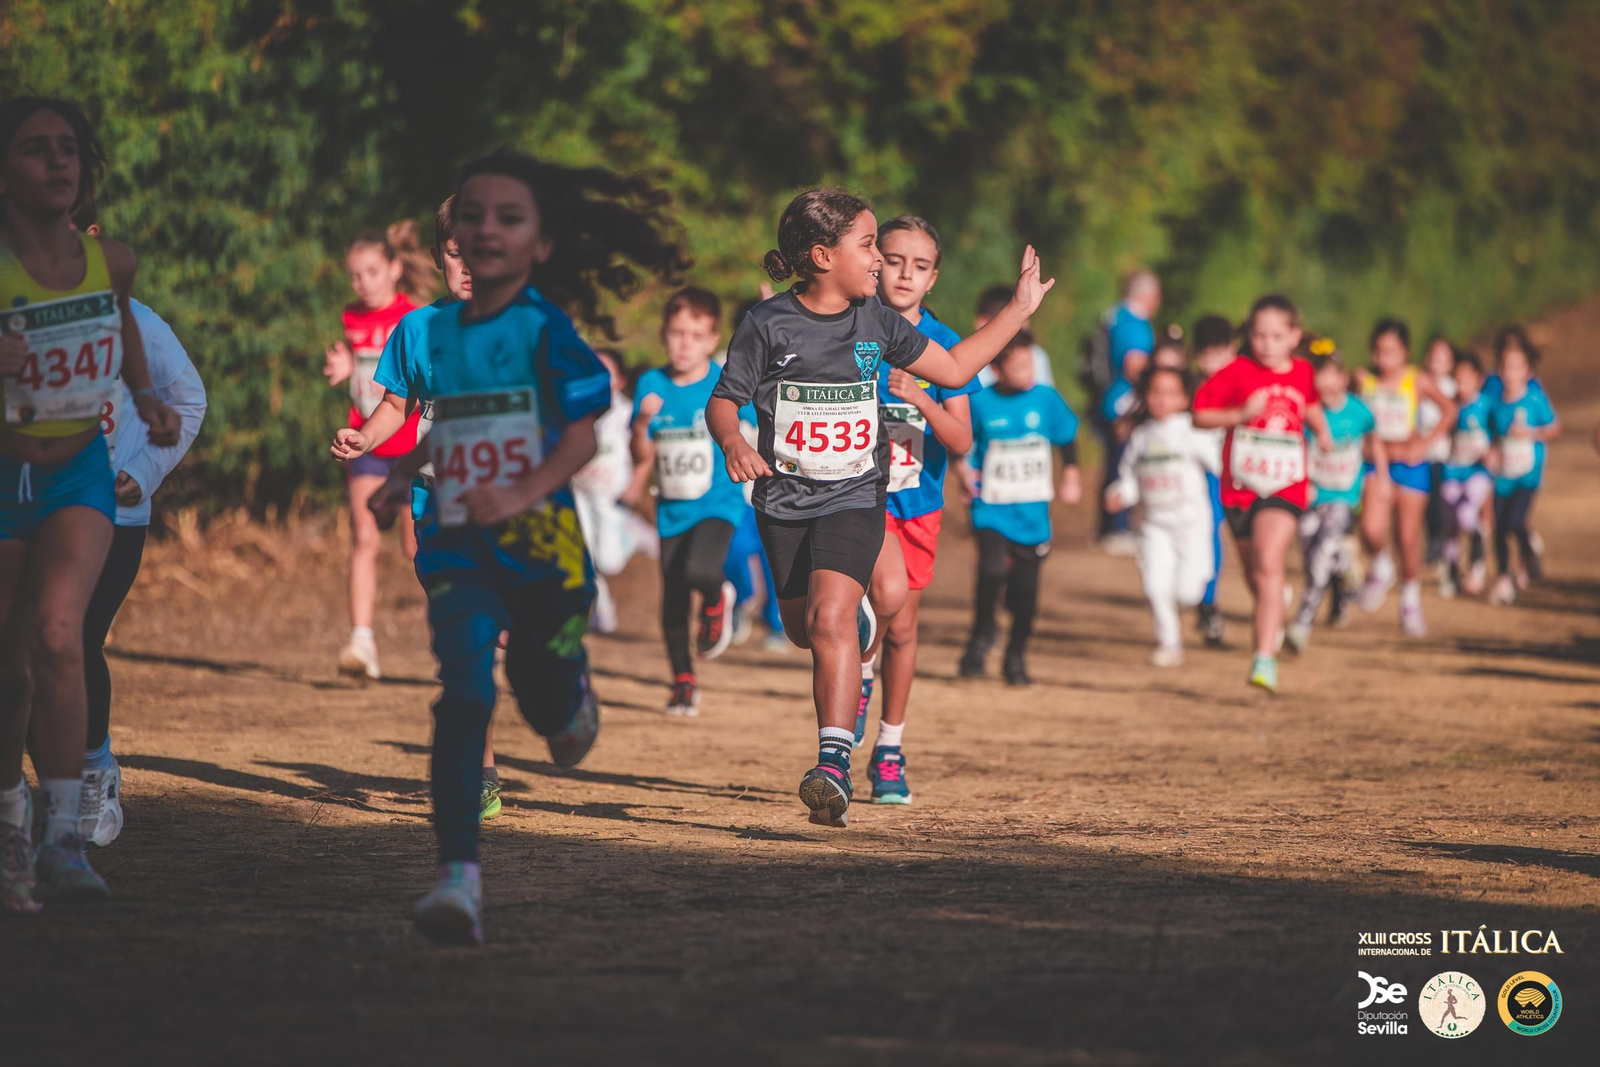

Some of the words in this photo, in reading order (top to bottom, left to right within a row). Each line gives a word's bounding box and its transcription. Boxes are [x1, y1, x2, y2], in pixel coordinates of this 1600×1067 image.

[16, 336, 115, 391] 4347
[806, 387, 855, 400] ITÁLICA
[785, 418, 871, 452] 4533
